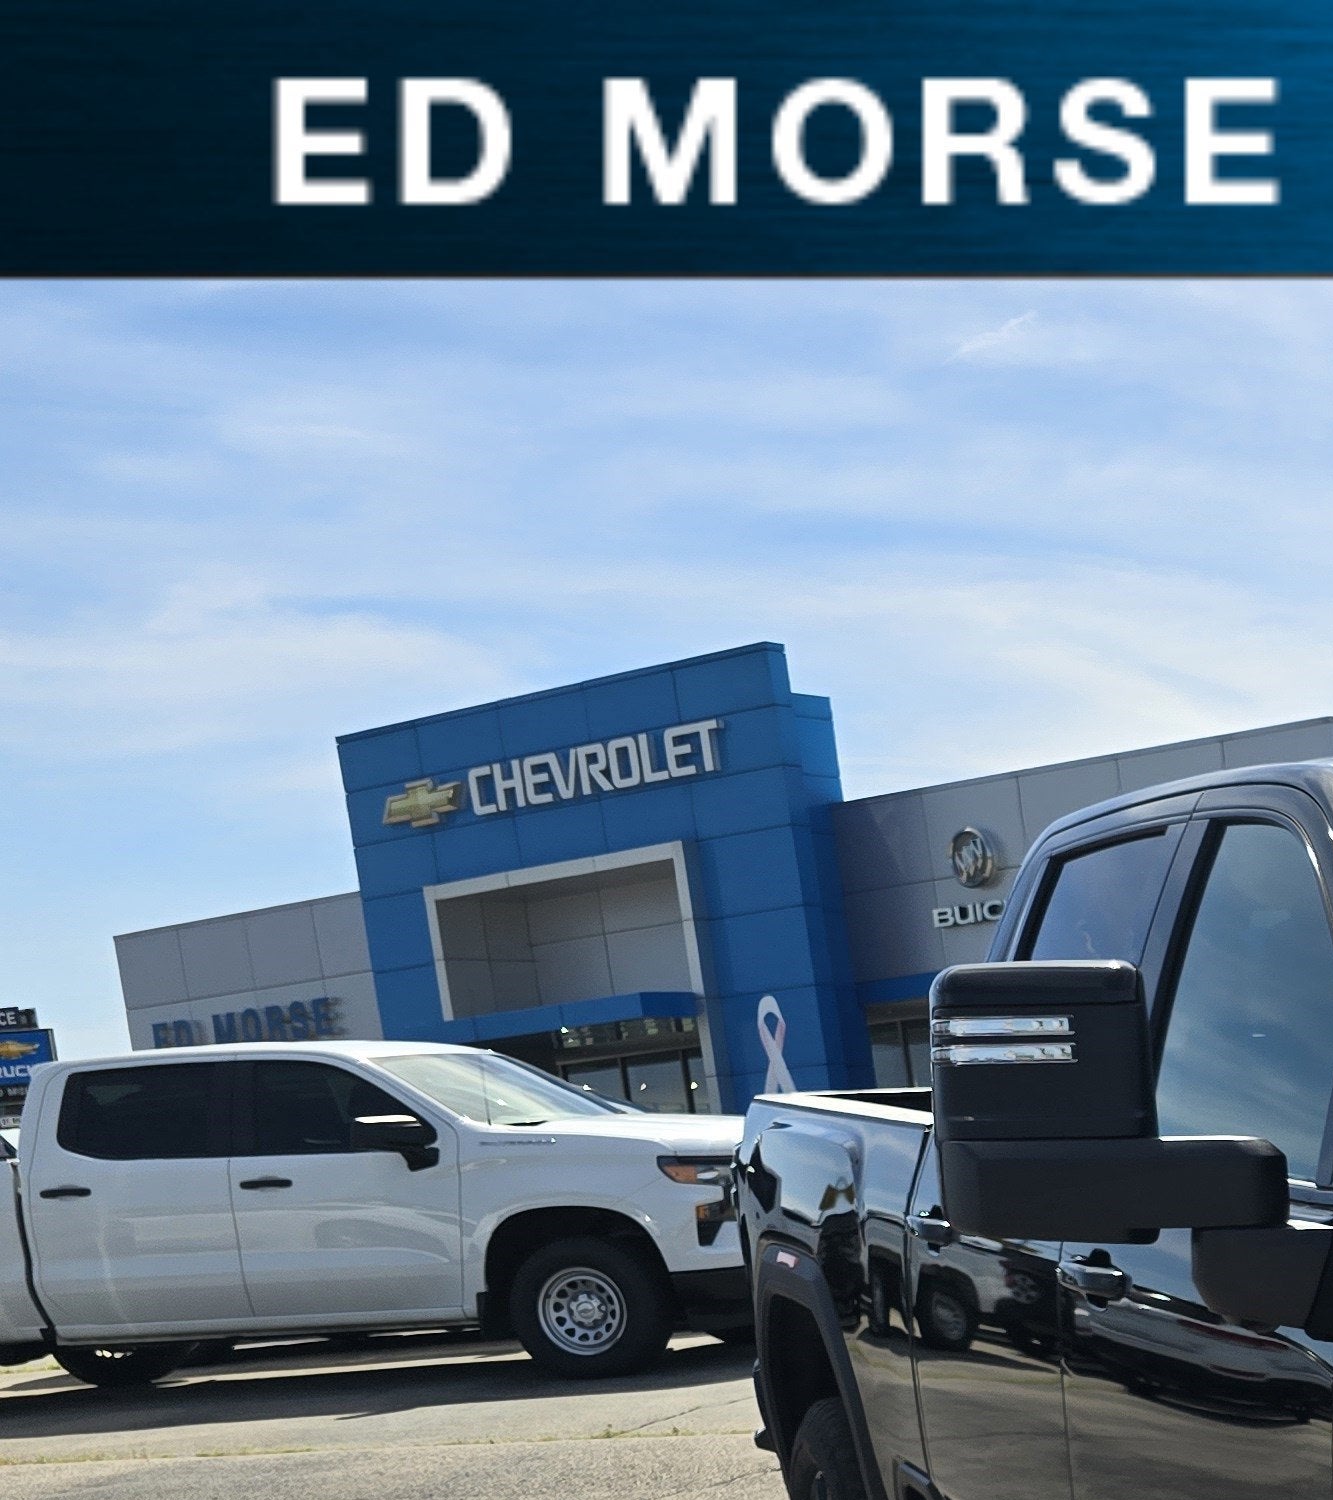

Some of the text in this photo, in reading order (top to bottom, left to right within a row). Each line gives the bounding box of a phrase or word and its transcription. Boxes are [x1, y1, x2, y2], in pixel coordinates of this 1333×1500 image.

[468, 719, 719, 816] CHEVROLET
[932, 899, 1005, 928] BUIC
[152, 997, 332, 1048] ED MORSE
